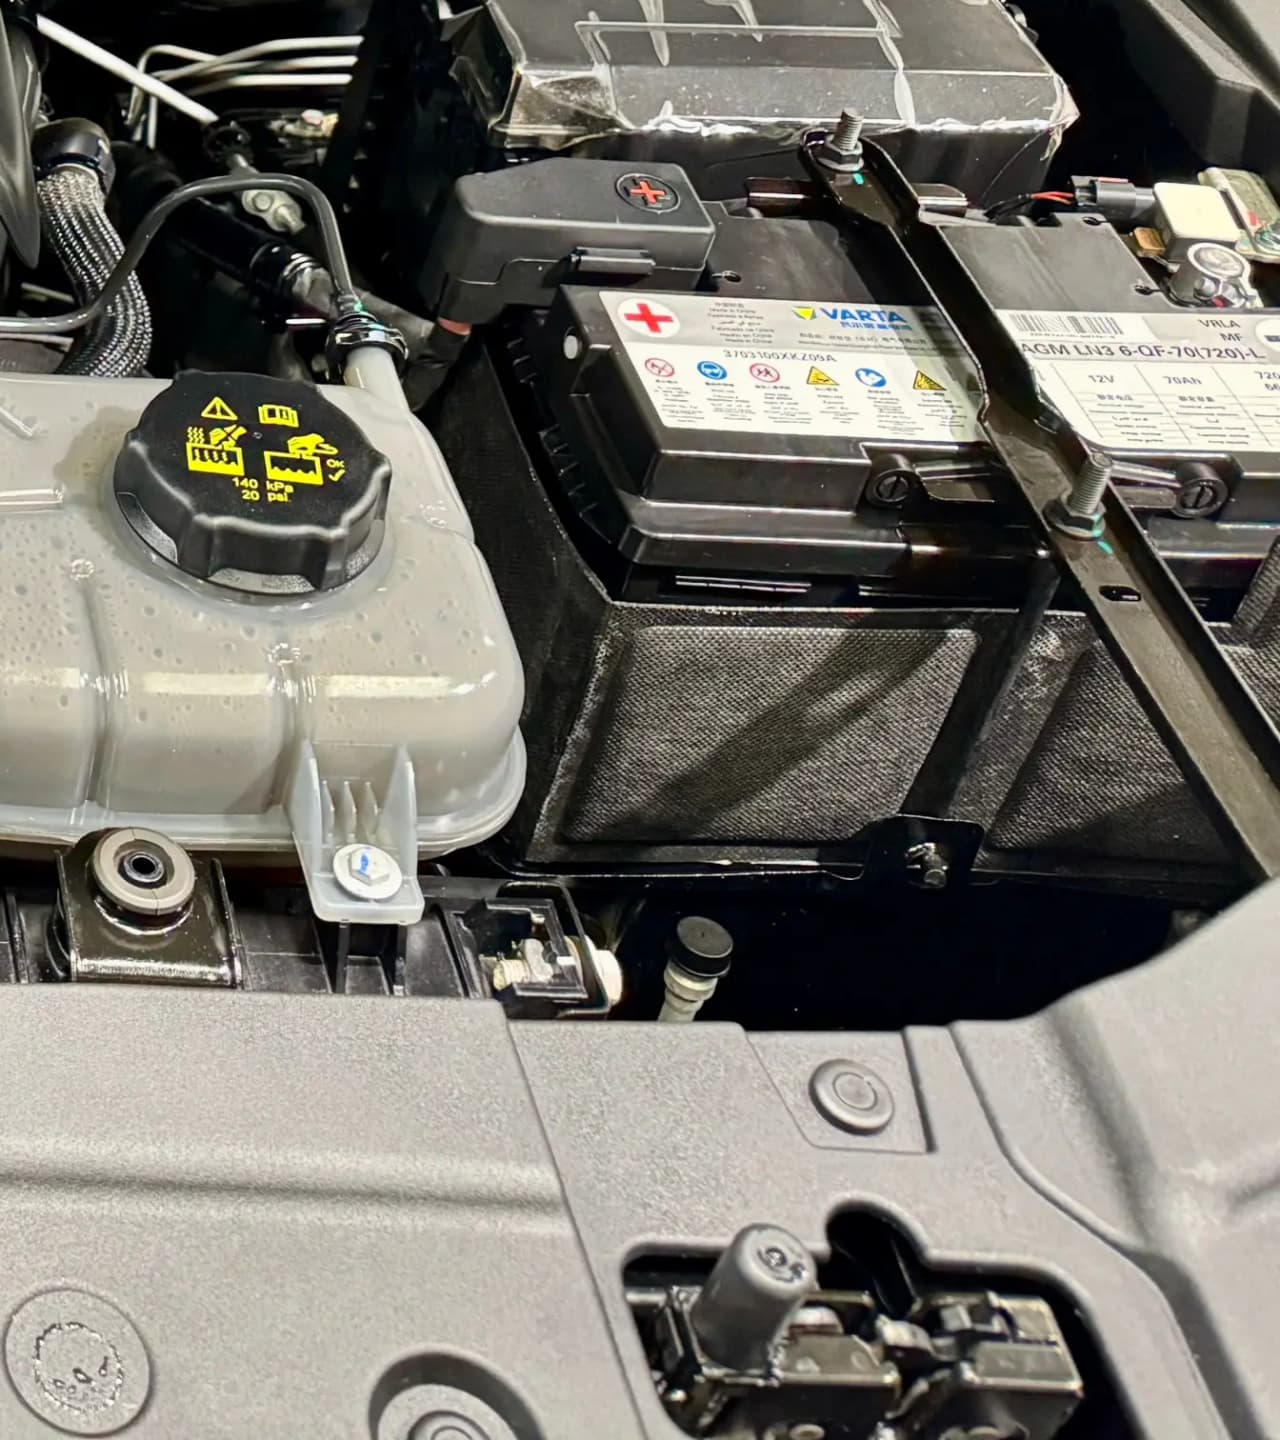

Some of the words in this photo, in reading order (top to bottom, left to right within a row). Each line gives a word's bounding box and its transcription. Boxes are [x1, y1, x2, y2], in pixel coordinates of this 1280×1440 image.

[819, 307, 908, 323] VARTA
[1198, 318, 1241, 329] VRLA
[1219, 332, 1244, 342] MF
[1020, 342, 1071, 356] AGM
[1073, 343, 1115, 357] LN3
[1119, 345, 1266, 360] 6-QF-70(720)-L
[1087, 374, 1115, 384] 12V
[1162, 375, 1203, 385] 70Ah
[325, 458, 346, 469] OK
[231, 476, 259, 489] 140
[265, 480, 294, 493] kPa
[241, 489, 261, 501] 20
[267, 492, 289, 502] psi
